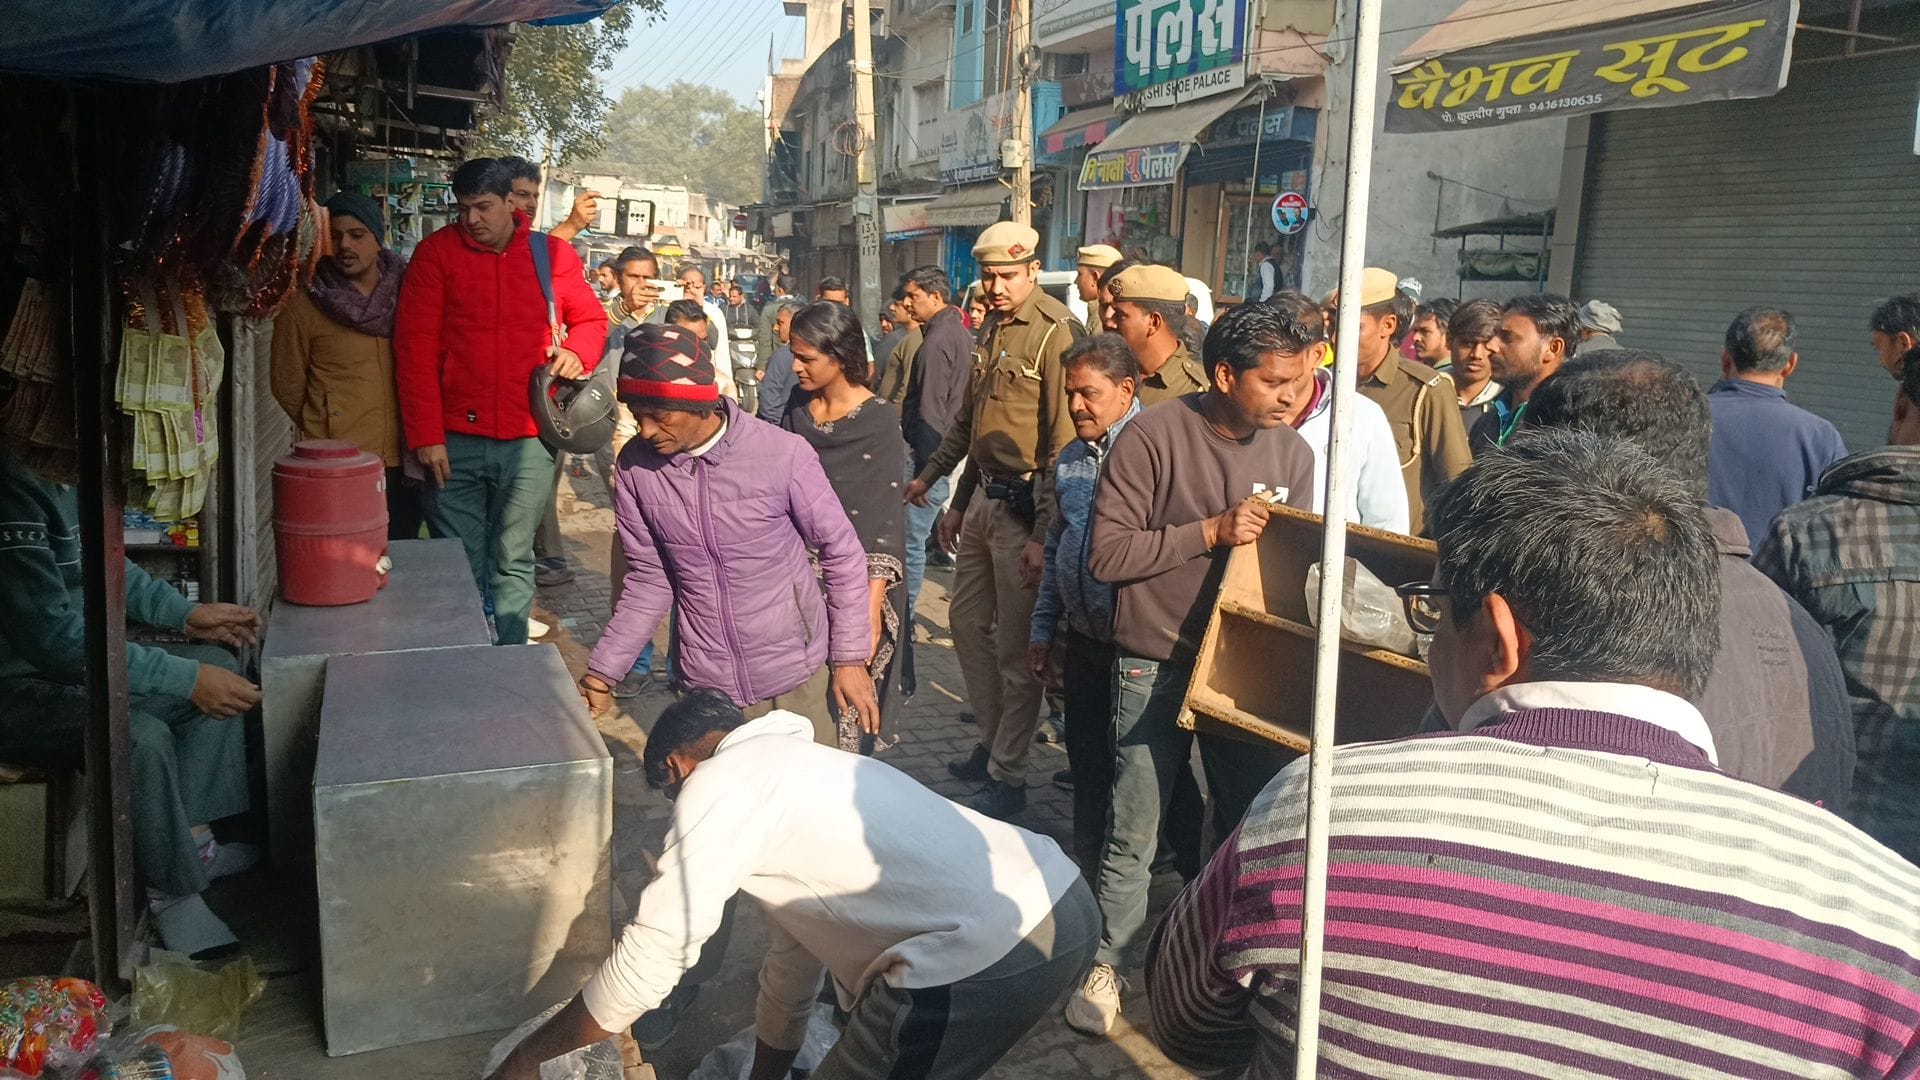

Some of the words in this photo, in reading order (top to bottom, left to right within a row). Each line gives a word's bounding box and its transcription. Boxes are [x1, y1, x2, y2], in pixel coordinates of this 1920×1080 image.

[1397, 50, 1580, 110] वैभव
[1594, 19, 1767, 98] सूट
[1166, 79, 1190, 96] SHOE
[1193, 69, 1231, 90] PALACE
[1457, 107, 1494, 125] कुलदीप
[1529, 93, 1602, 113] 9416130635
